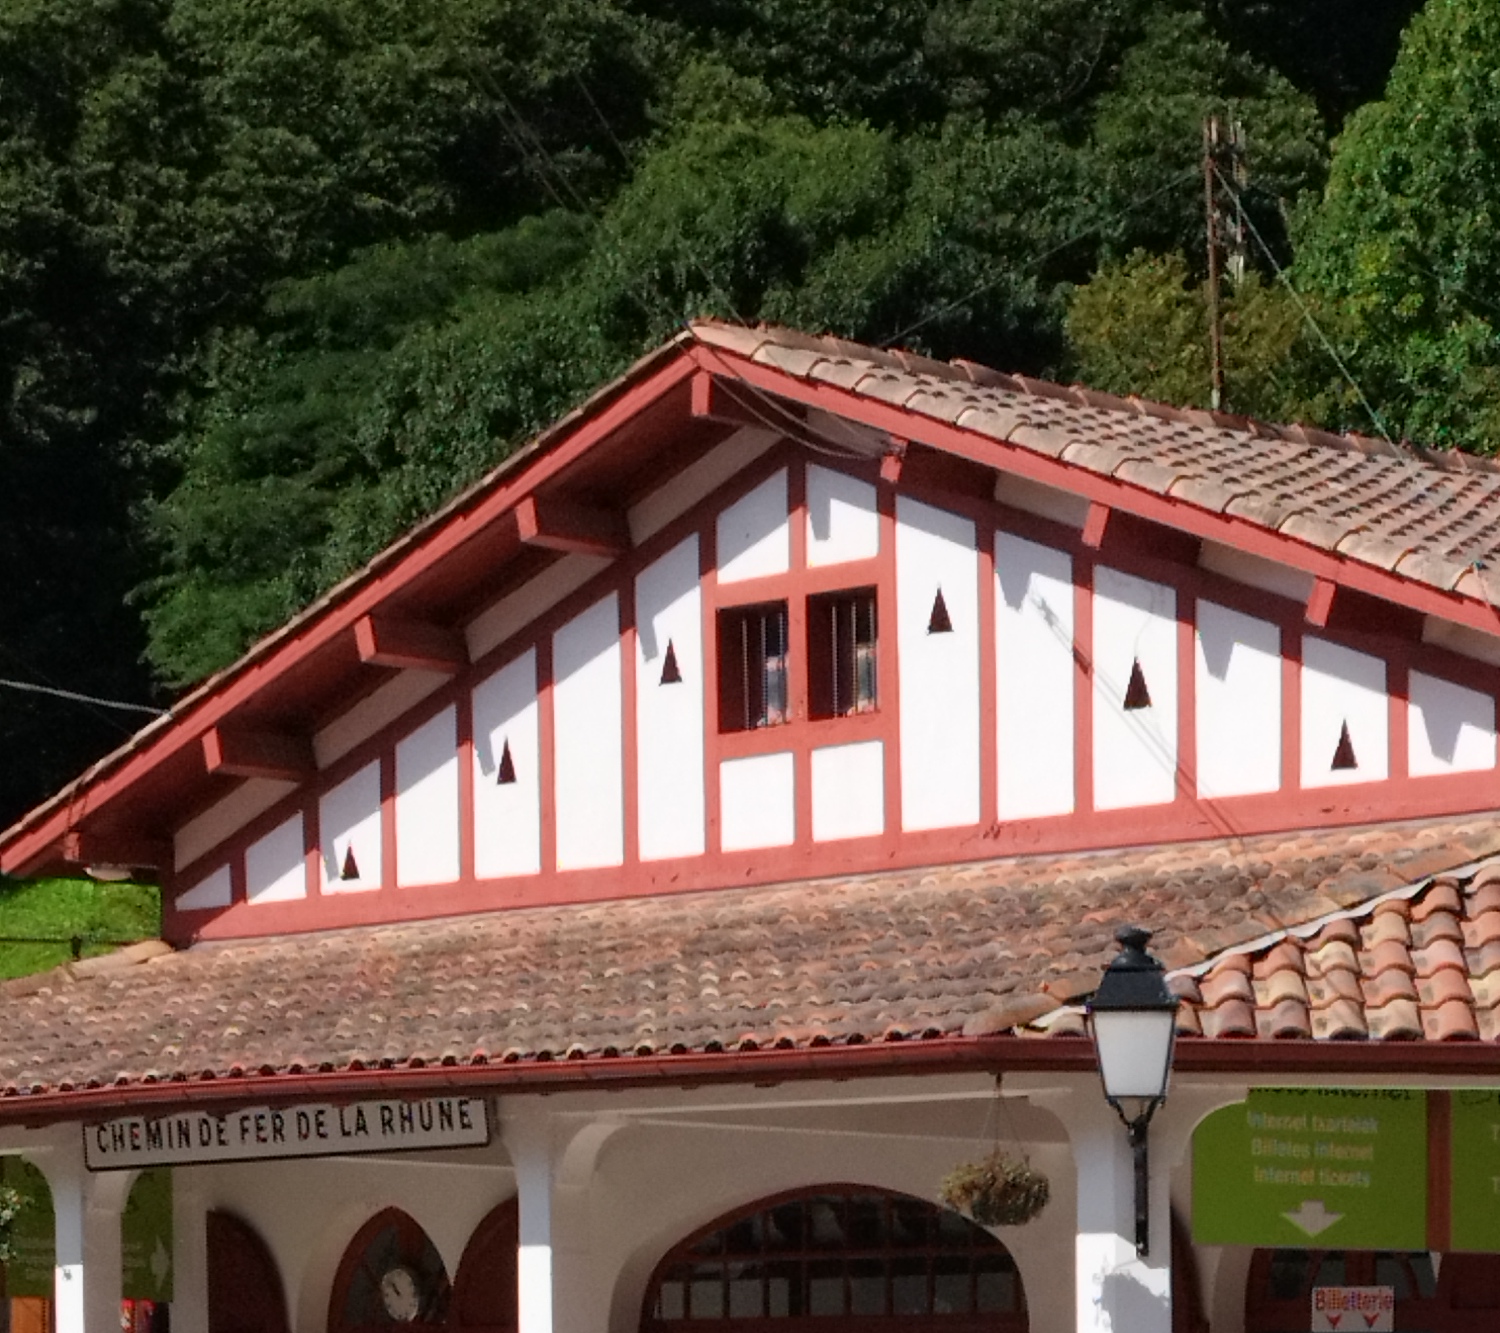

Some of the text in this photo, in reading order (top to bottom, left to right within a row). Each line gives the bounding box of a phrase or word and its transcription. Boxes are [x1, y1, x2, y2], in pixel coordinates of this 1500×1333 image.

[97, 1101, 473, 1153] CHEMIN DE FER DE LA RHUNE
[1315, 1289, 1392, 1311] Billetterie
